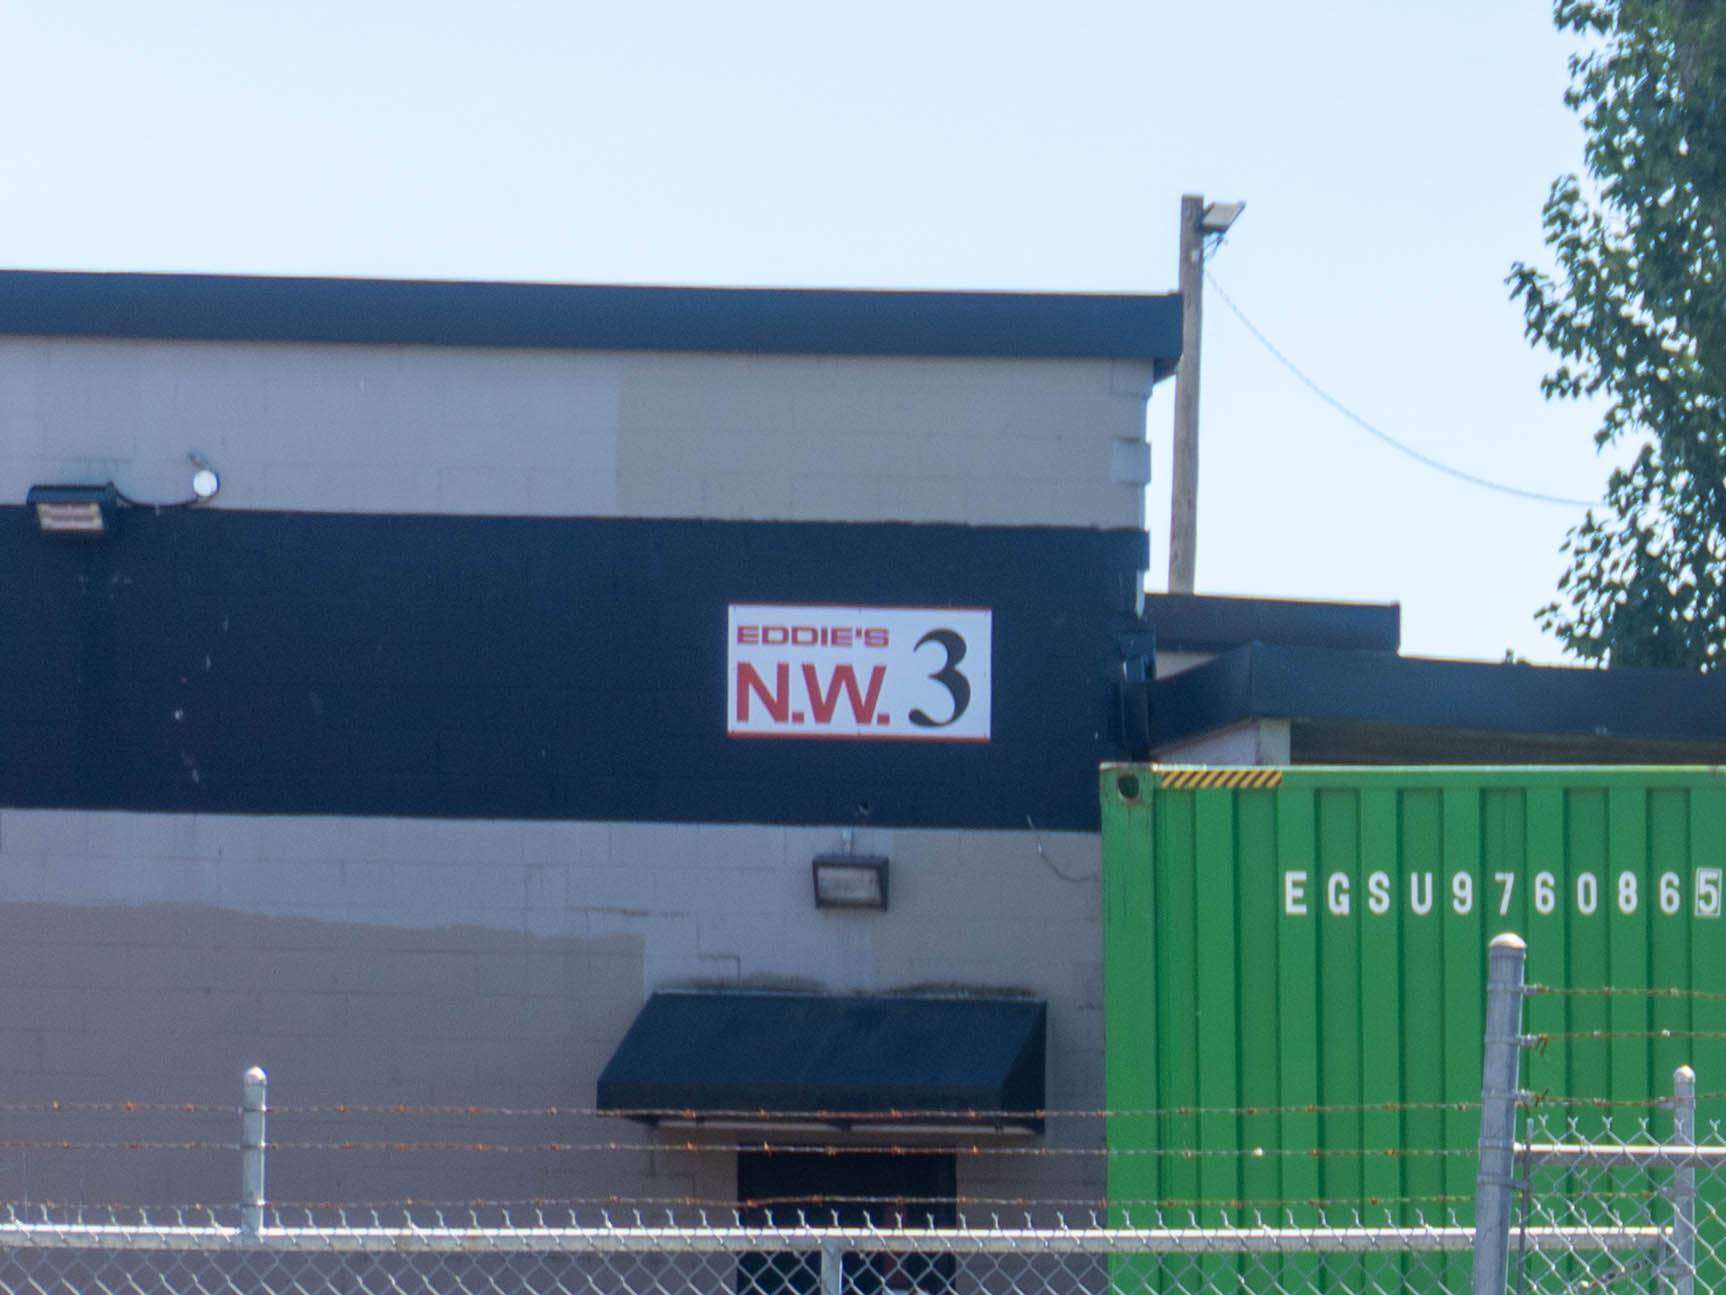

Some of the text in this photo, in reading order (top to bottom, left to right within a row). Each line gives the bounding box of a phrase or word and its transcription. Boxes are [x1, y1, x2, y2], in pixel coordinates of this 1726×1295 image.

[736, 625, 890, 647] EDDIE'S
[736, 661, 890, 725] N.W.
[908, 628, 971, 727] 3
[1284, 869, 1721, 916] EGSU9760865
